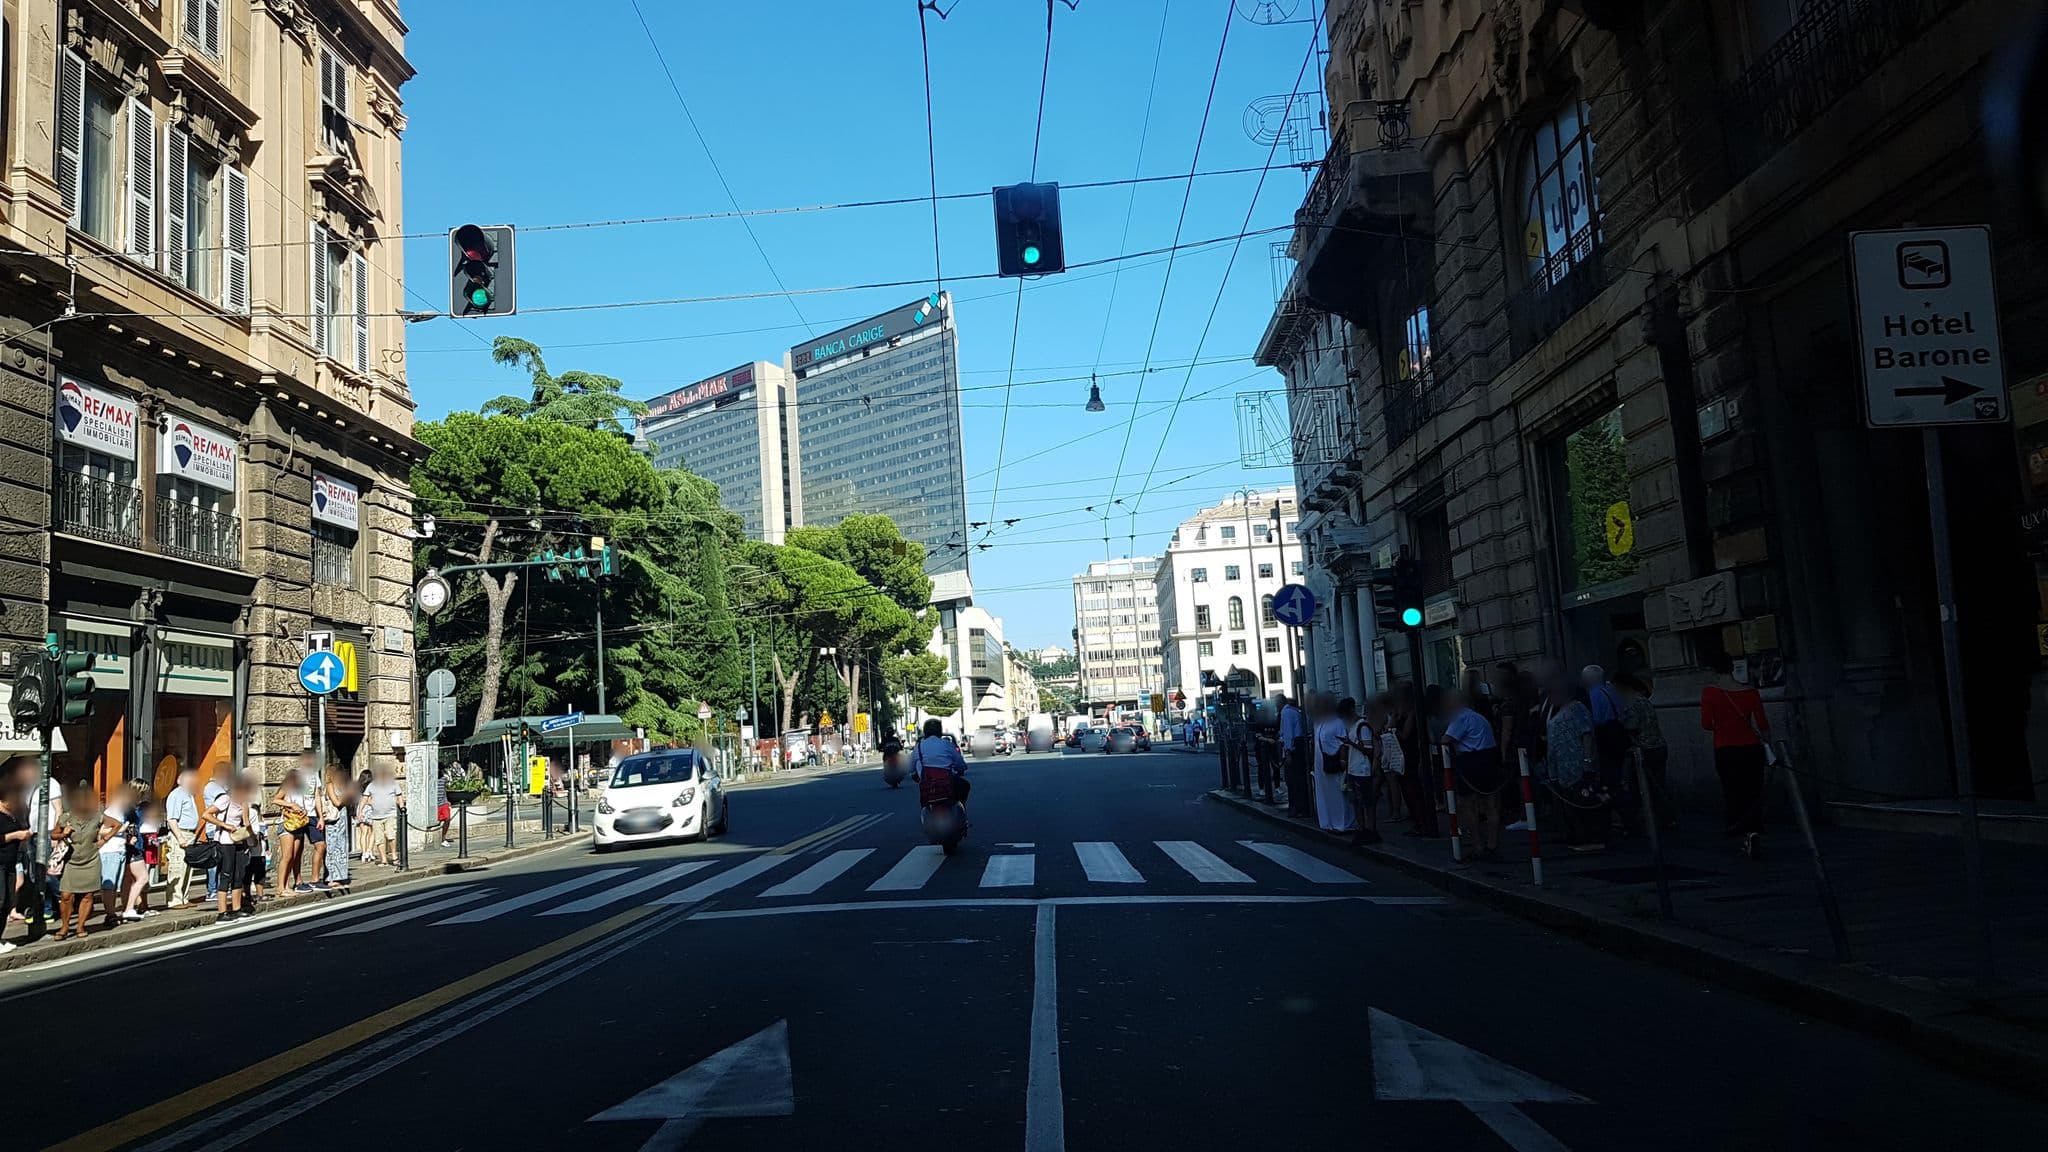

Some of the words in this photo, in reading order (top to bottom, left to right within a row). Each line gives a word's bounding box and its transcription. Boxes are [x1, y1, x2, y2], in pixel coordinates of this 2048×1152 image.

[1551, 162, 1600, 235] upi
[1884, 312, 1975, 337] Hotel
[814, 339, 846, 361] BANCA
[848, 324, 884, 348] CARIGE
[1874, 347, 1991, 370] Barone
[84, 395, 133, 428] RE/MAX
[83, 416, 132, 438] SPECIALISTI
[83, 427, 132, 449] IMMOBILIARI
[193, 436, 232, 462] RE/MAX
[193, 454, 232, 473] SPECIALISTI
[193, 463, 232, 481] IMMOBILIARI
[328, 484, 357, 506] RE/MAX
[164, 643, 225, 671] THUN
